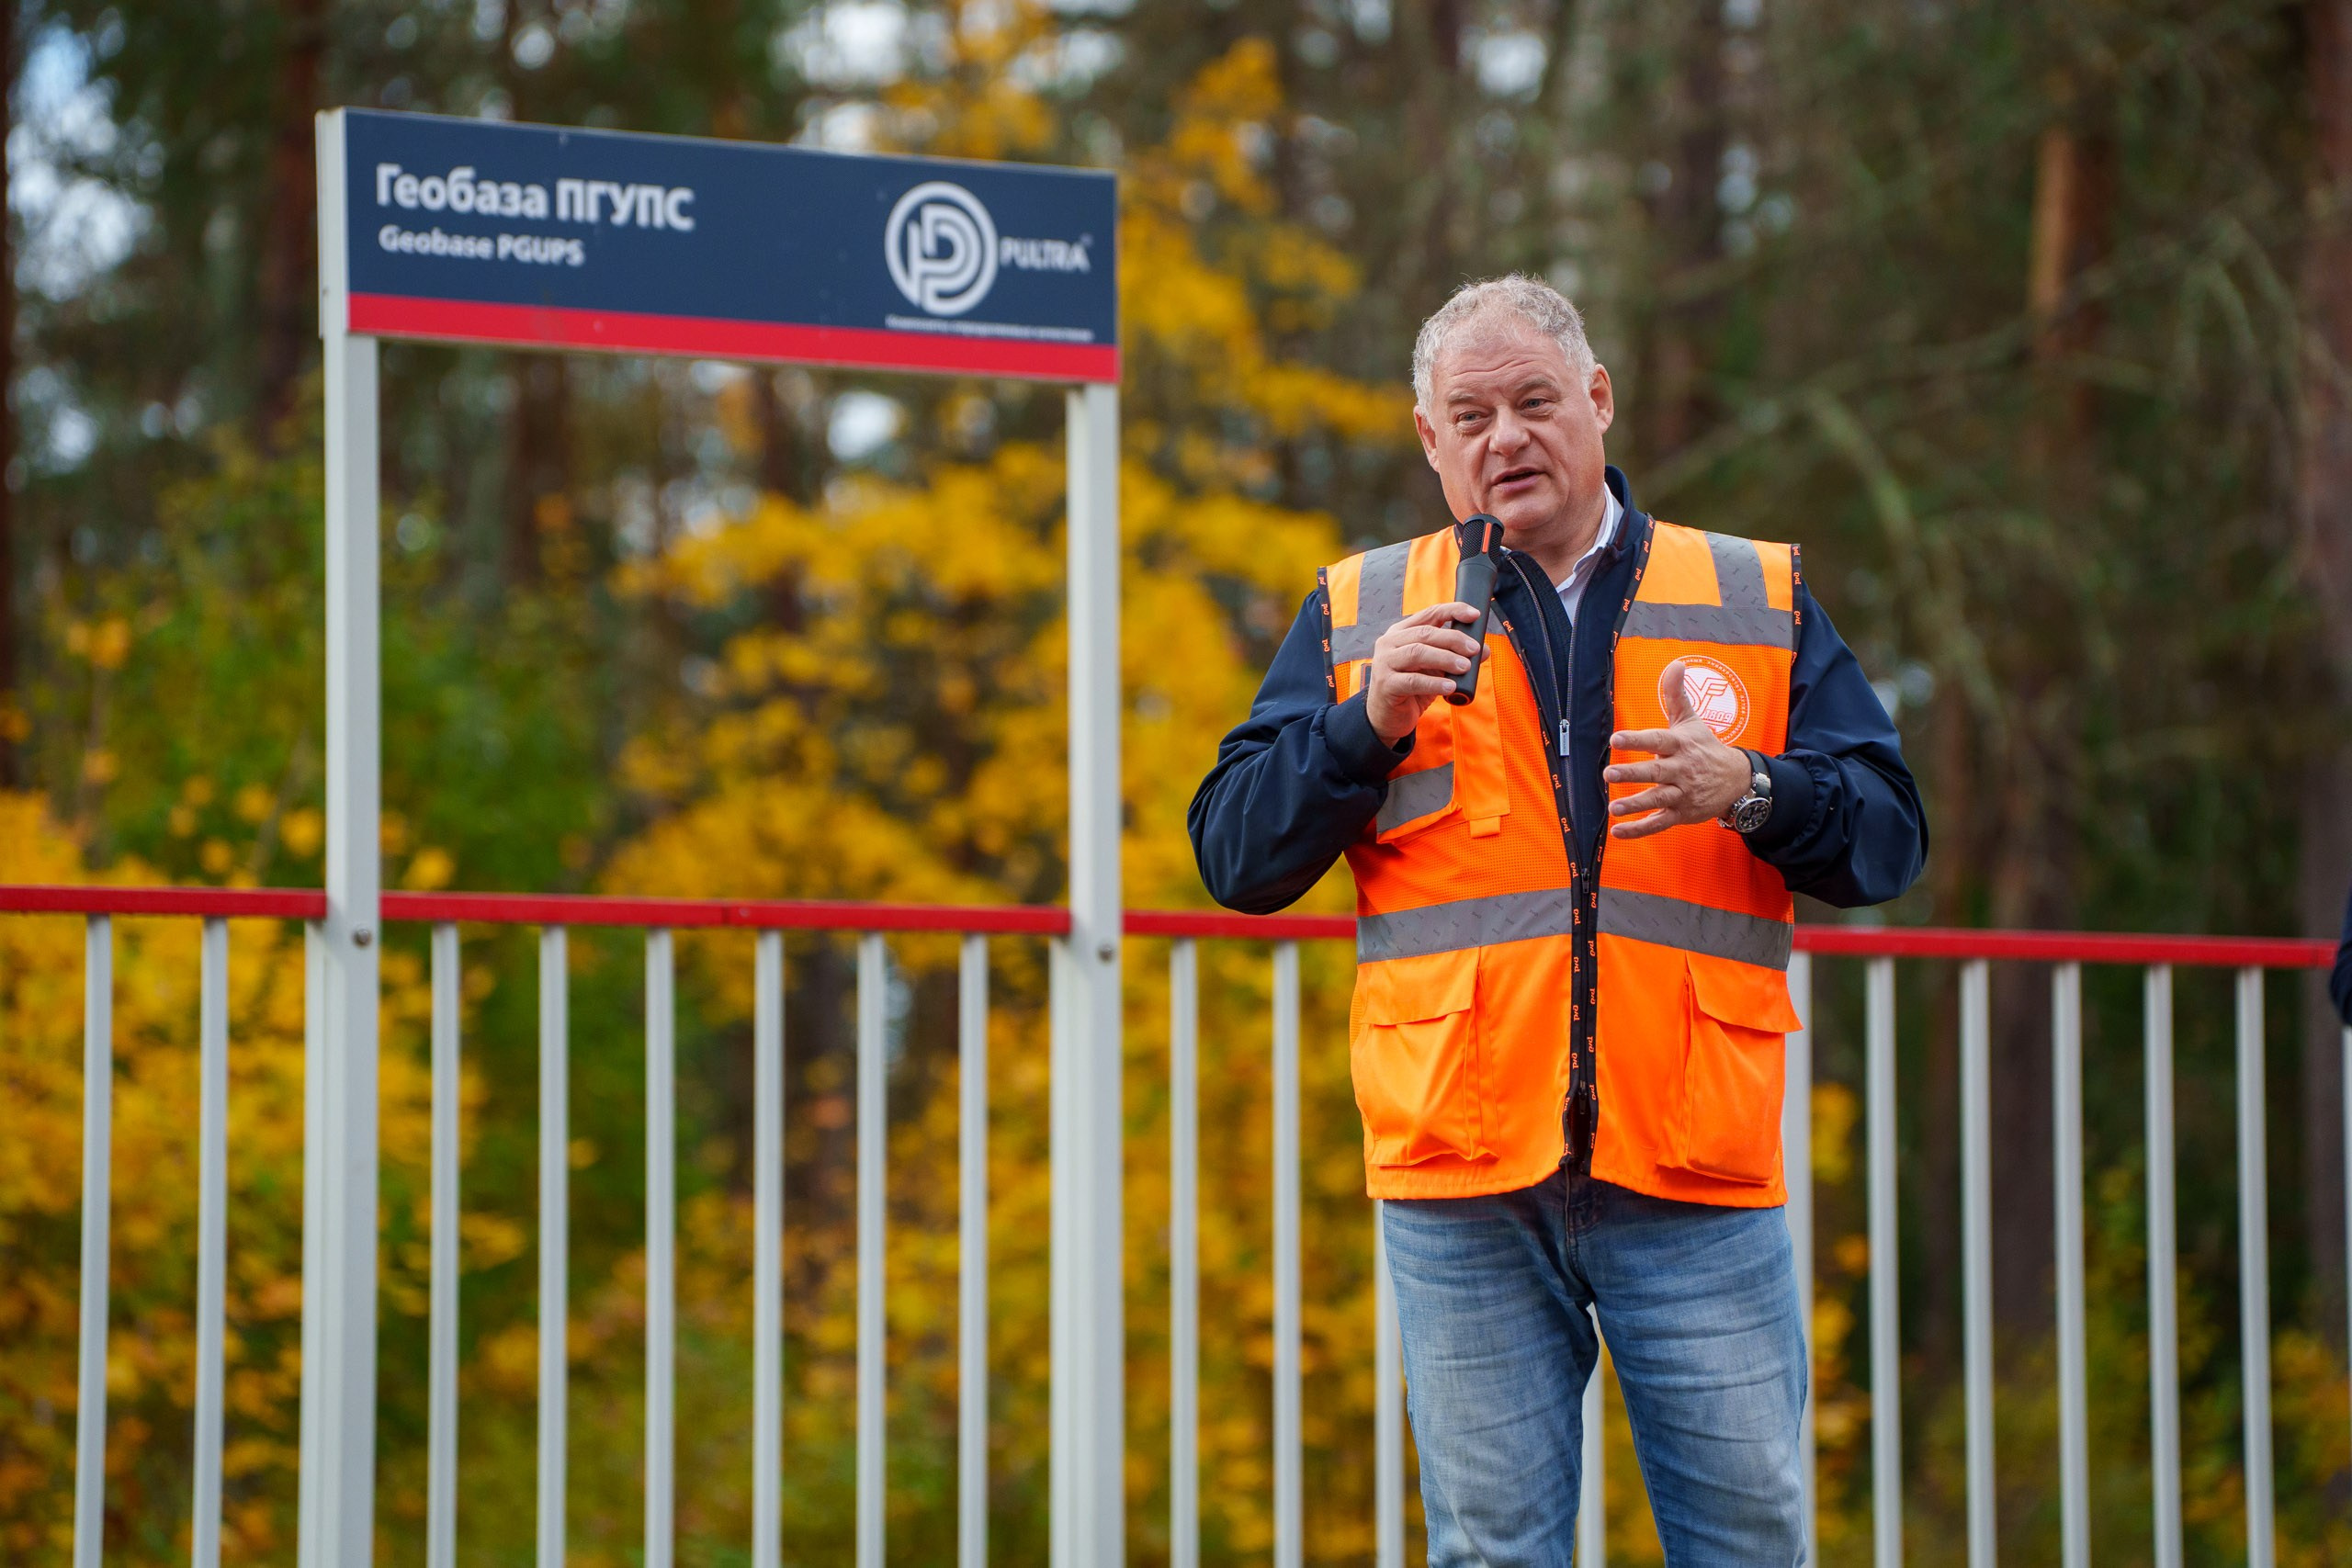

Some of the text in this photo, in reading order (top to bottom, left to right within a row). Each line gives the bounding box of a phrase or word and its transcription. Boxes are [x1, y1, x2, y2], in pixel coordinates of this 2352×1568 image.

[376, 162, 695, 232] Геобаза ПГУПС
[379, 224, 585, 267] Geobase PGUPS
[1705, 708, 1734, 724] 1809
